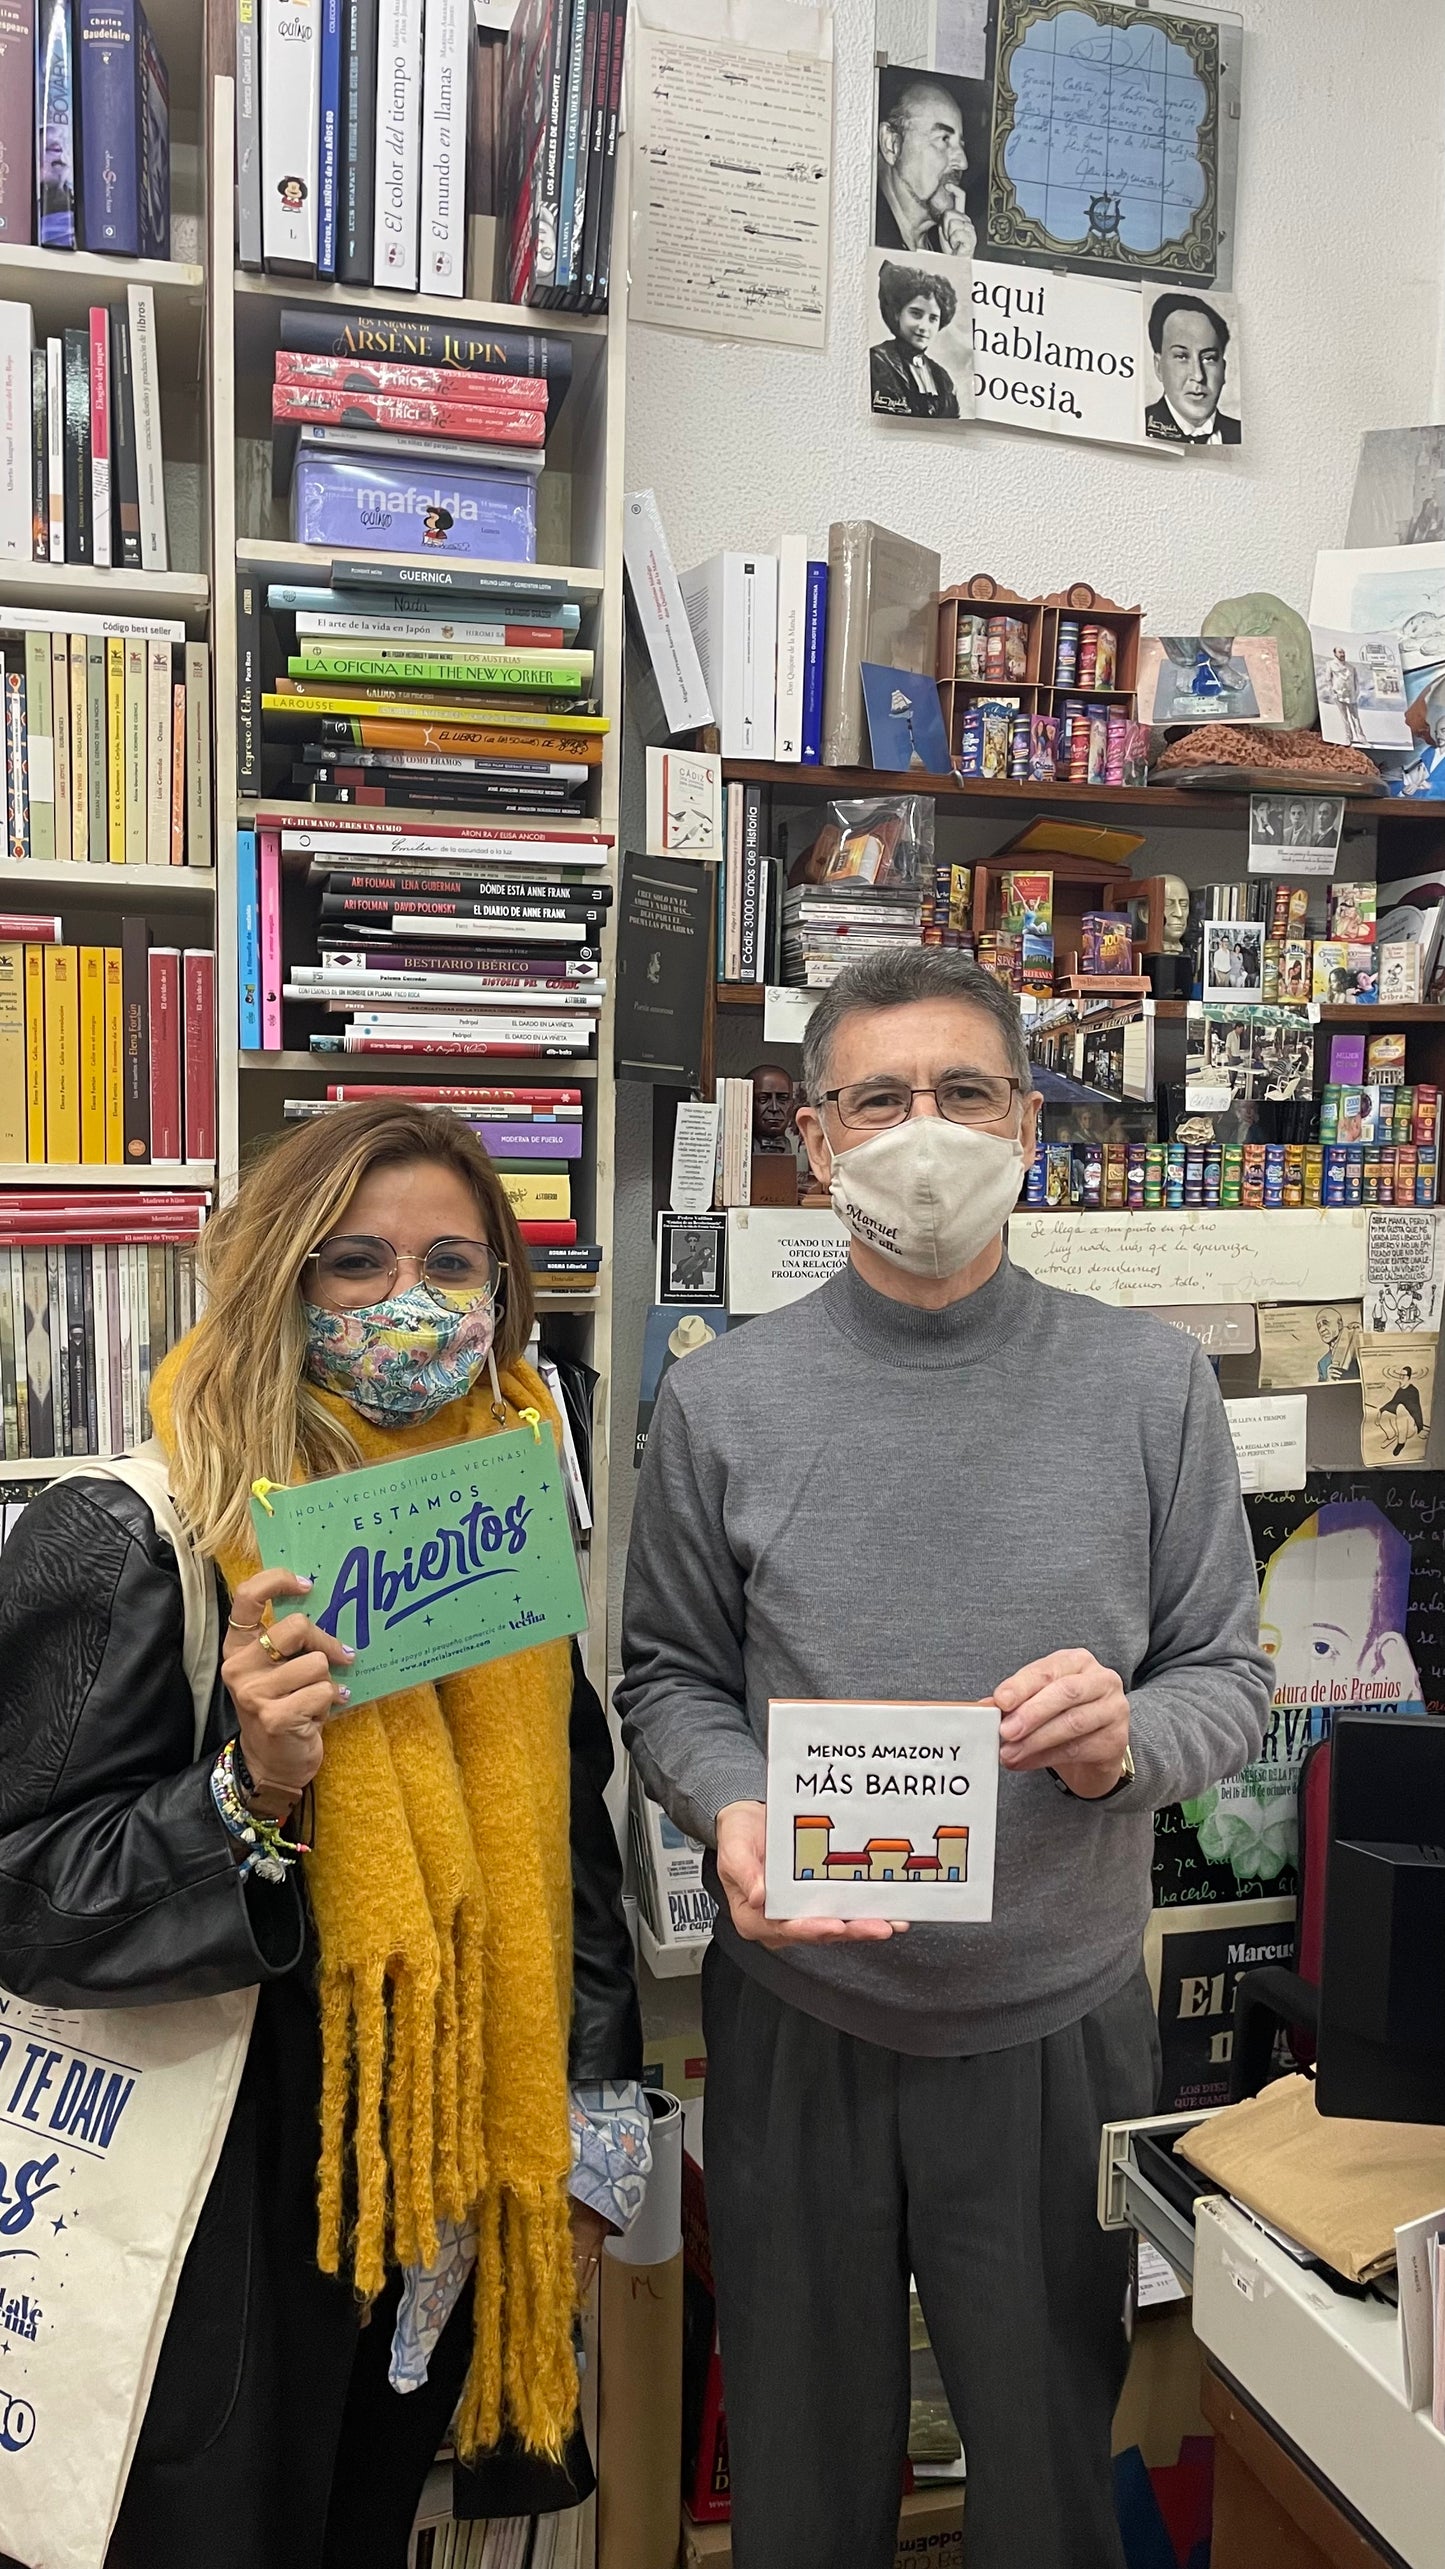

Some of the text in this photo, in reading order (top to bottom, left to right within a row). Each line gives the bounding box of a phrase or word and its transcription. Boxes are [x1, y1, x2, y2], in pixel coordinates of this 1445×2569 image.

[83, 30, 131, 42] Baudelaire
[385, 56, 411, 208] color del tiempo
[433, 66, 453, 217] mundo en llamas
[547, 74, 561, 196] LOS ÁNGELES DE AUSCHWITZ
[136, 302, 146, 332] libros
[441, 335, 507, 370] LUPIN
[972, 318, 1135, 379] hablamos
[95, 342, 105, 410] Elogio del papel
[356, 485, 479, 522] mafalda
[399, 569, 452, 585] GUERNICA
[103, 621, 171, 636] Código best seller
[329, 620, 431, 636] arte de la vida en Japón
[463, 654, 480, 663] LOS
[481, 655, 521, 665] AUSTRIAS
[786, 609, 796, 697] Don Quijote Mancha
[305, 659, 554, 685] LA OFICINA EN THE NEW YORKER
[272, 699, 335, 711] LAROUSSE
[240, 715, 254, 775] Regreso al
[453, 731, 482, 743] LIBRO
[297, 819, 517, 840] HUMANO, ERES UN SIMIO ARON RA ELISA
[351, 877, 571, 899] ARI FOLMAN LENA GUBERMAN DÓNDE ESTÁ ANNE FRANK
[741, 806, 758, 964] Cádiz 3000 años de Historia
[344, 899, 566, 919] ARI FOLMAN DAVID POLONSKY EL DIARIO DE ANNE FRANK
[404, 958, 529, 972] BESTIARIO IBÉRICO
[128, 1003, 138, 1056] Elena Fortún
[501, 1135, 564, 1145] MODERNA DE PUEBLO
[846, 1203, 900, 1241] Manuel
[1050, 1220, 1217, 1242] llega a punto en no
[1387, 1225, 1405, 1233] GUSTA
[125, 1234, 132, 1242] El
[778, 1239, 834, 1248] "CUANDO UN
[1077, 1241, 1111, 1253] nada
[1120, 1240, 1143, 1253] más
[1175, 1240, 1188, 1253] la
[569, 1250, 589, 1258] Editorial
[781, 1258, 848, 1269] UNA RELACIÓN
[789, 1249, 821, 1258] OFICIO
[566, 1263, 587, 1271] Editorial
[1034, 1261, 1083, 1276] entonces
[1088, 1277, 1163, 1292] lo tenemos
[1263, 1414, 1287, 1422] TIEMPOS
[1244, 1442, 1271, 1450] REGALAR
[354, 1484, 481, 1531] ESTAMOS
[316, 1495, 535, 1650] Abiertos
[520, 1609, 534, 1620] La
[355, 1661, 389, 1677] Proyecto
[390, 1658, 399, 1667] de
[401, 1652, 423, 1664] apoyo
[425, 1648, 431, 1656] al
[432, 1638, 463, 1654] pequeño
[399, 1638, 492, 1673] www.agencialavecina.com
[1274, 1677, 1401, 1706] atura de los Premios
[807, 1745, 961, 1761] MENOS AMAZON Y
[796, 1763, 970, 1797] MÁS BARRIO
[1221, 1784, 1291, 1801] Del al de octubre
[1160, 1880, 1225, 1907] hacerlo.
[673, 1922, 687, 1932] de
[1177, 1972, 1226, 2020] El
[7, 2042, 136, 2150] TE DAN
